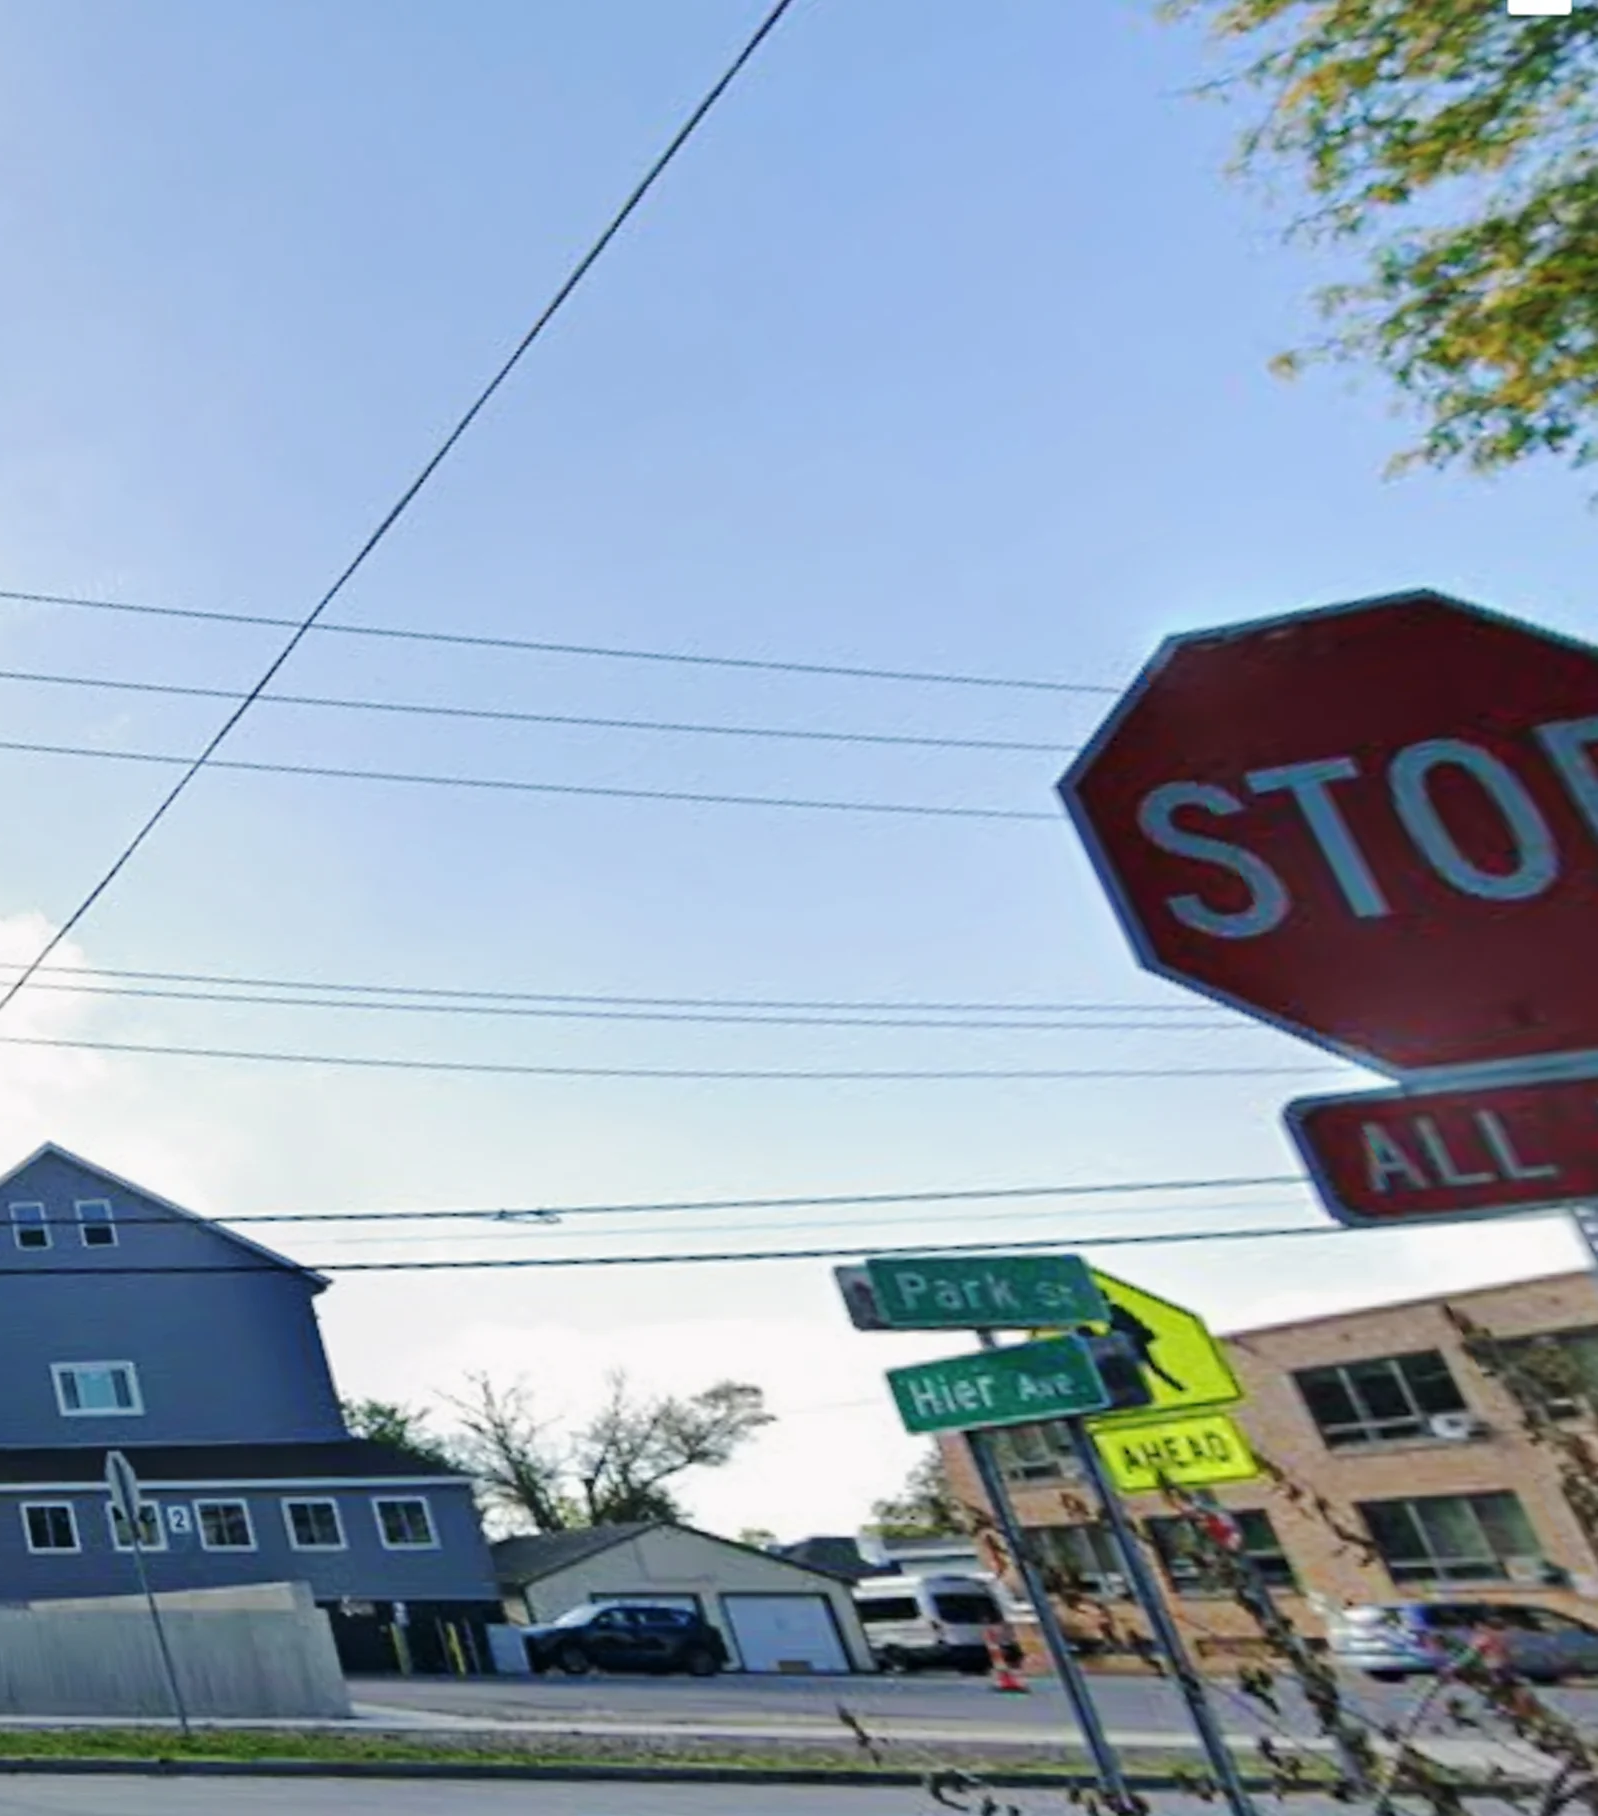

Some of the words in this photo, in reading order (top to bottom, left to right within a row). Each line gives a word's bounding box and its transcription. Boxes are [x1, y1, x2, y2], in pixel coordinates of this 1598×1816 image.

[1360, 1110, 1558, 1193] ALL
[894, 1270, 1023, 1311] Park
[1035, 1280, 1074, 1307] St
[908, 1374, 995, 1418] Hier
[1123, 1431, 1232, 1474] AHEAD
[172, 1510, 185, 1528] 2
